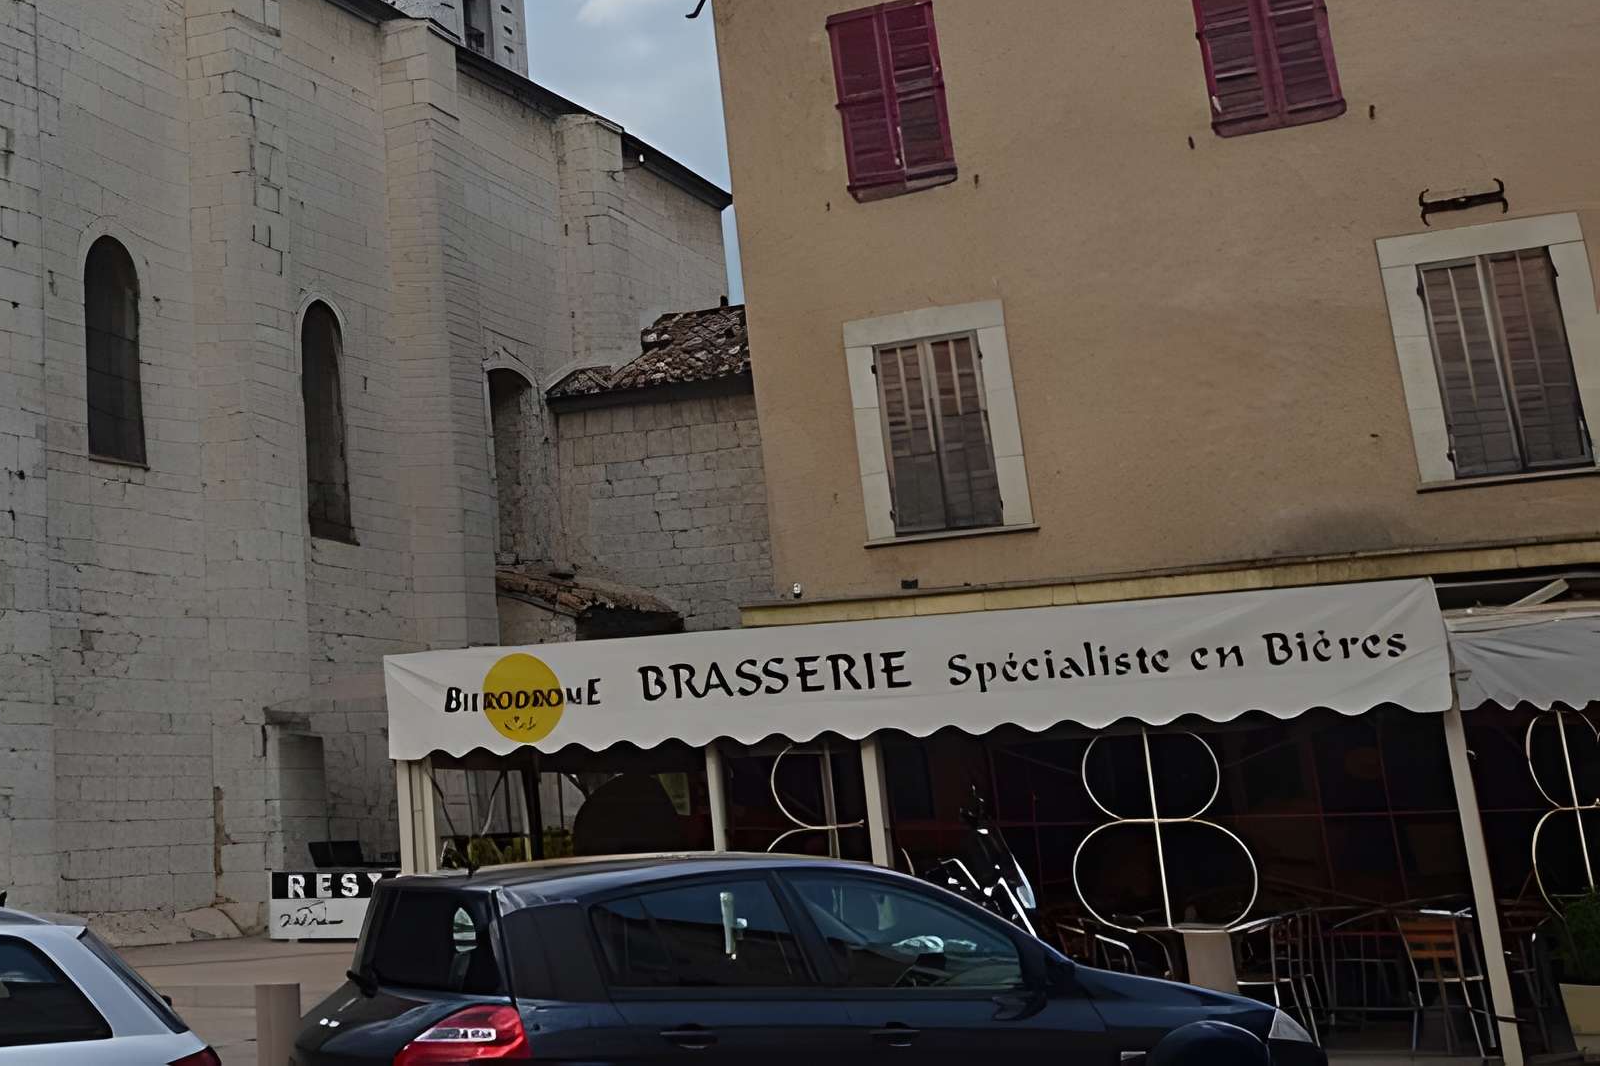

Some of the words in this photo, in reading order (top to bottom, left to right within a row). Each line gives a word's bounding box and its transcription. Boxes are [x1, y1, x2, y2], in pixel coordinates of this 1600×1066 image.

[636, 650, 913, 702] BRASSERIE
[947, 641, 1170, 693] Spécialiste
[1190, 644, 1244, 671] en
